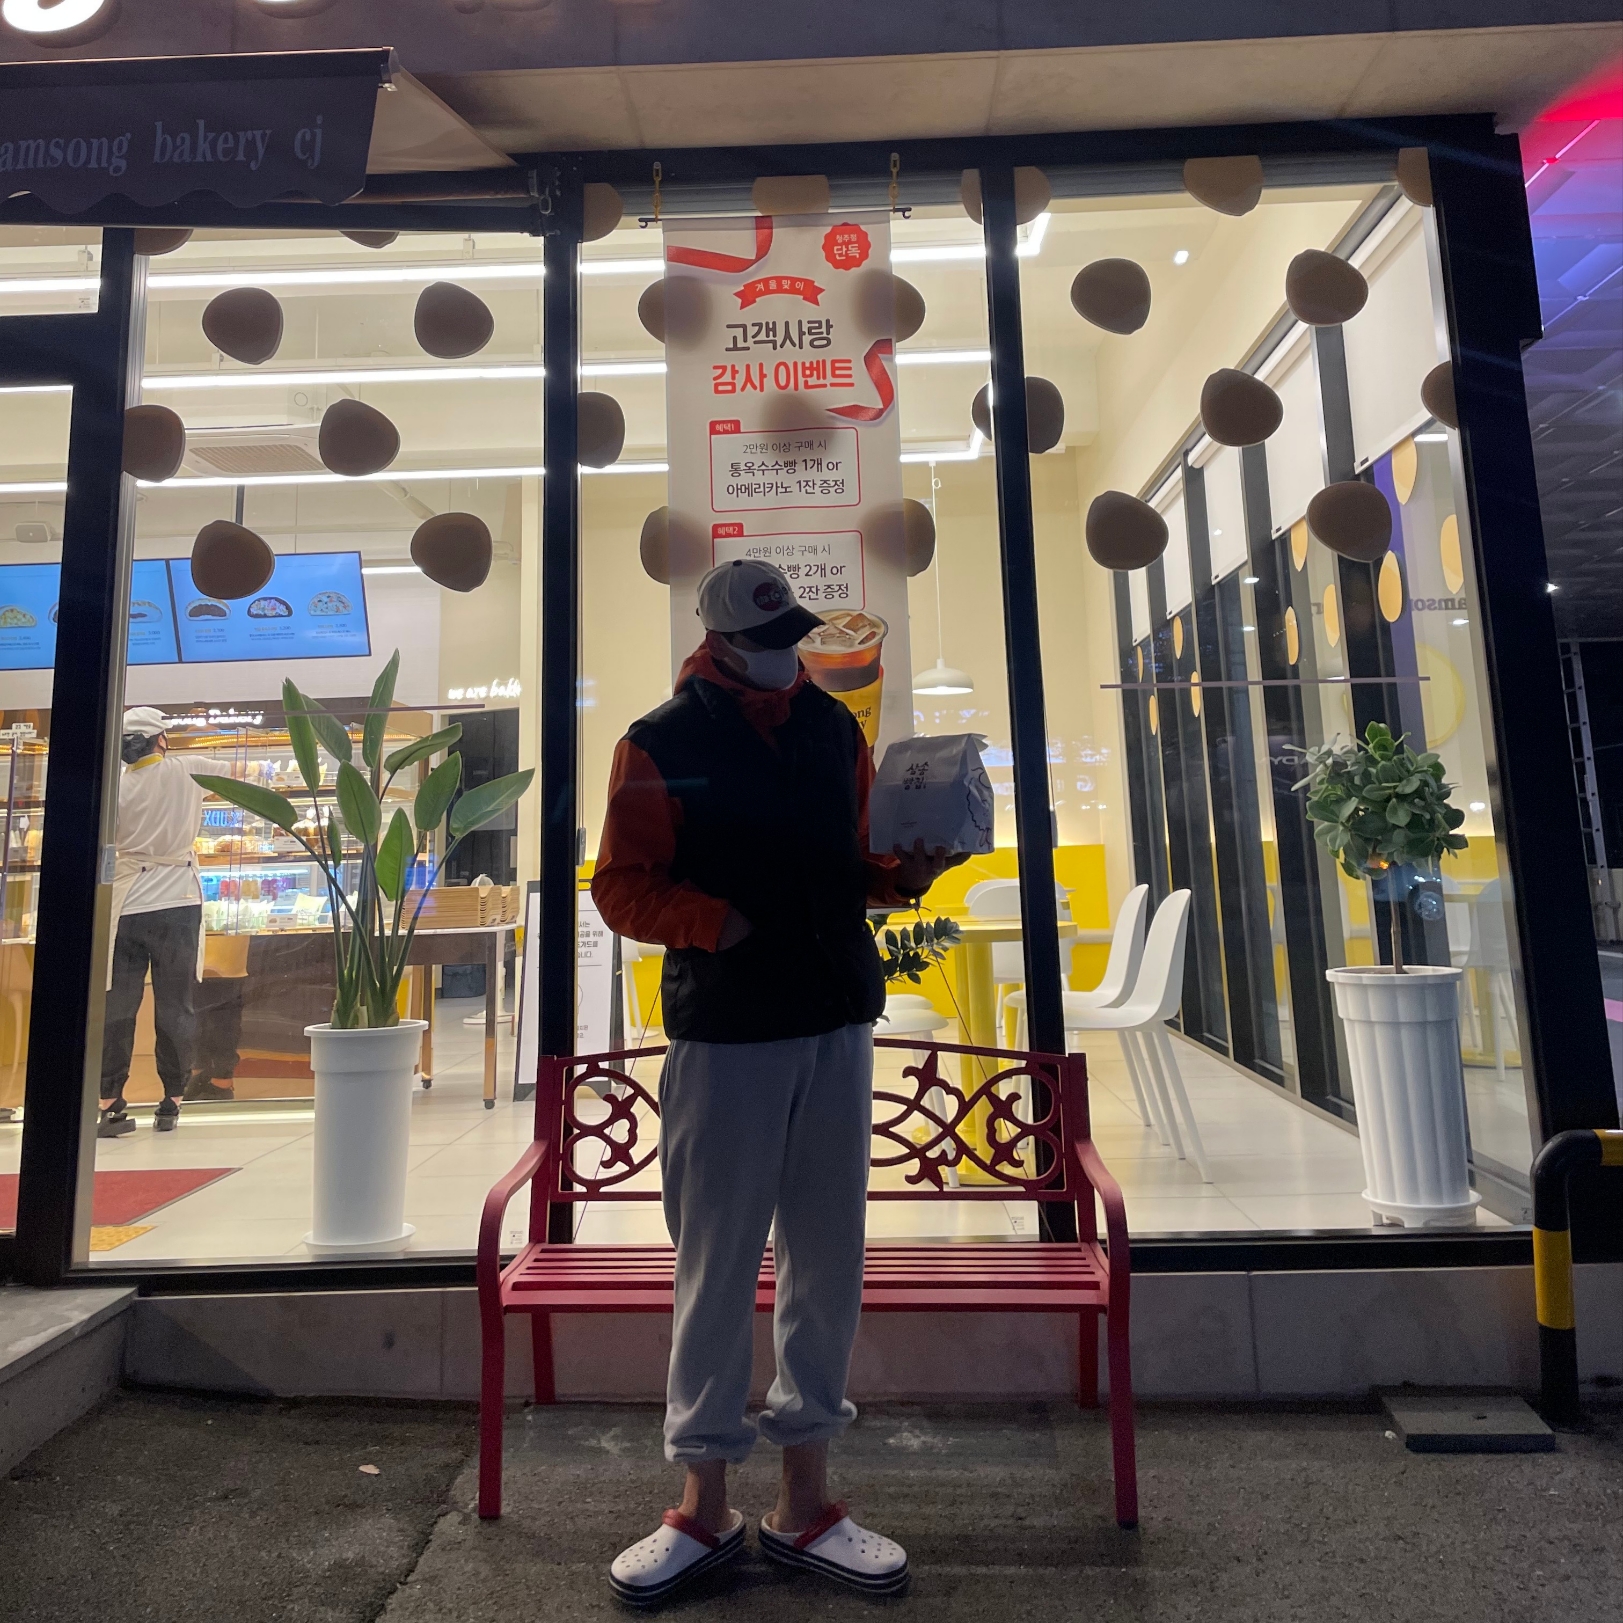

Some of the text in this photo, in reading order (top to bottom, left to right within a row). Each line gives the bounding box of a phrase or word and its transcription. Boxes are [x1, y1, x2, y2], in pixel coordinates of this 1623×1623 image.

[153, 119, 272, 171] bakery
[294, 114, 324, 169] cj
[833, 243, 861, 260] 단독
[725, 318, 834, 352] 고객사랑
[712, 358, 856, 395] 감사 이벤트
[742, 439, 827, 454] 2만원 이상 구매 시
[728, 458, 842, 478] 통옥수수빵 1개 or
[726, 478, 846, 498] 아메리카노 1잔 증정
[745, 544, 831, 558] 4만원 이상 구매 시
[804, 563, 827, 578] 2개
[830, 564, 846, 576] or
[798, 585, 820, 601] 2잔
[822, 583, 850, 599] 증정
